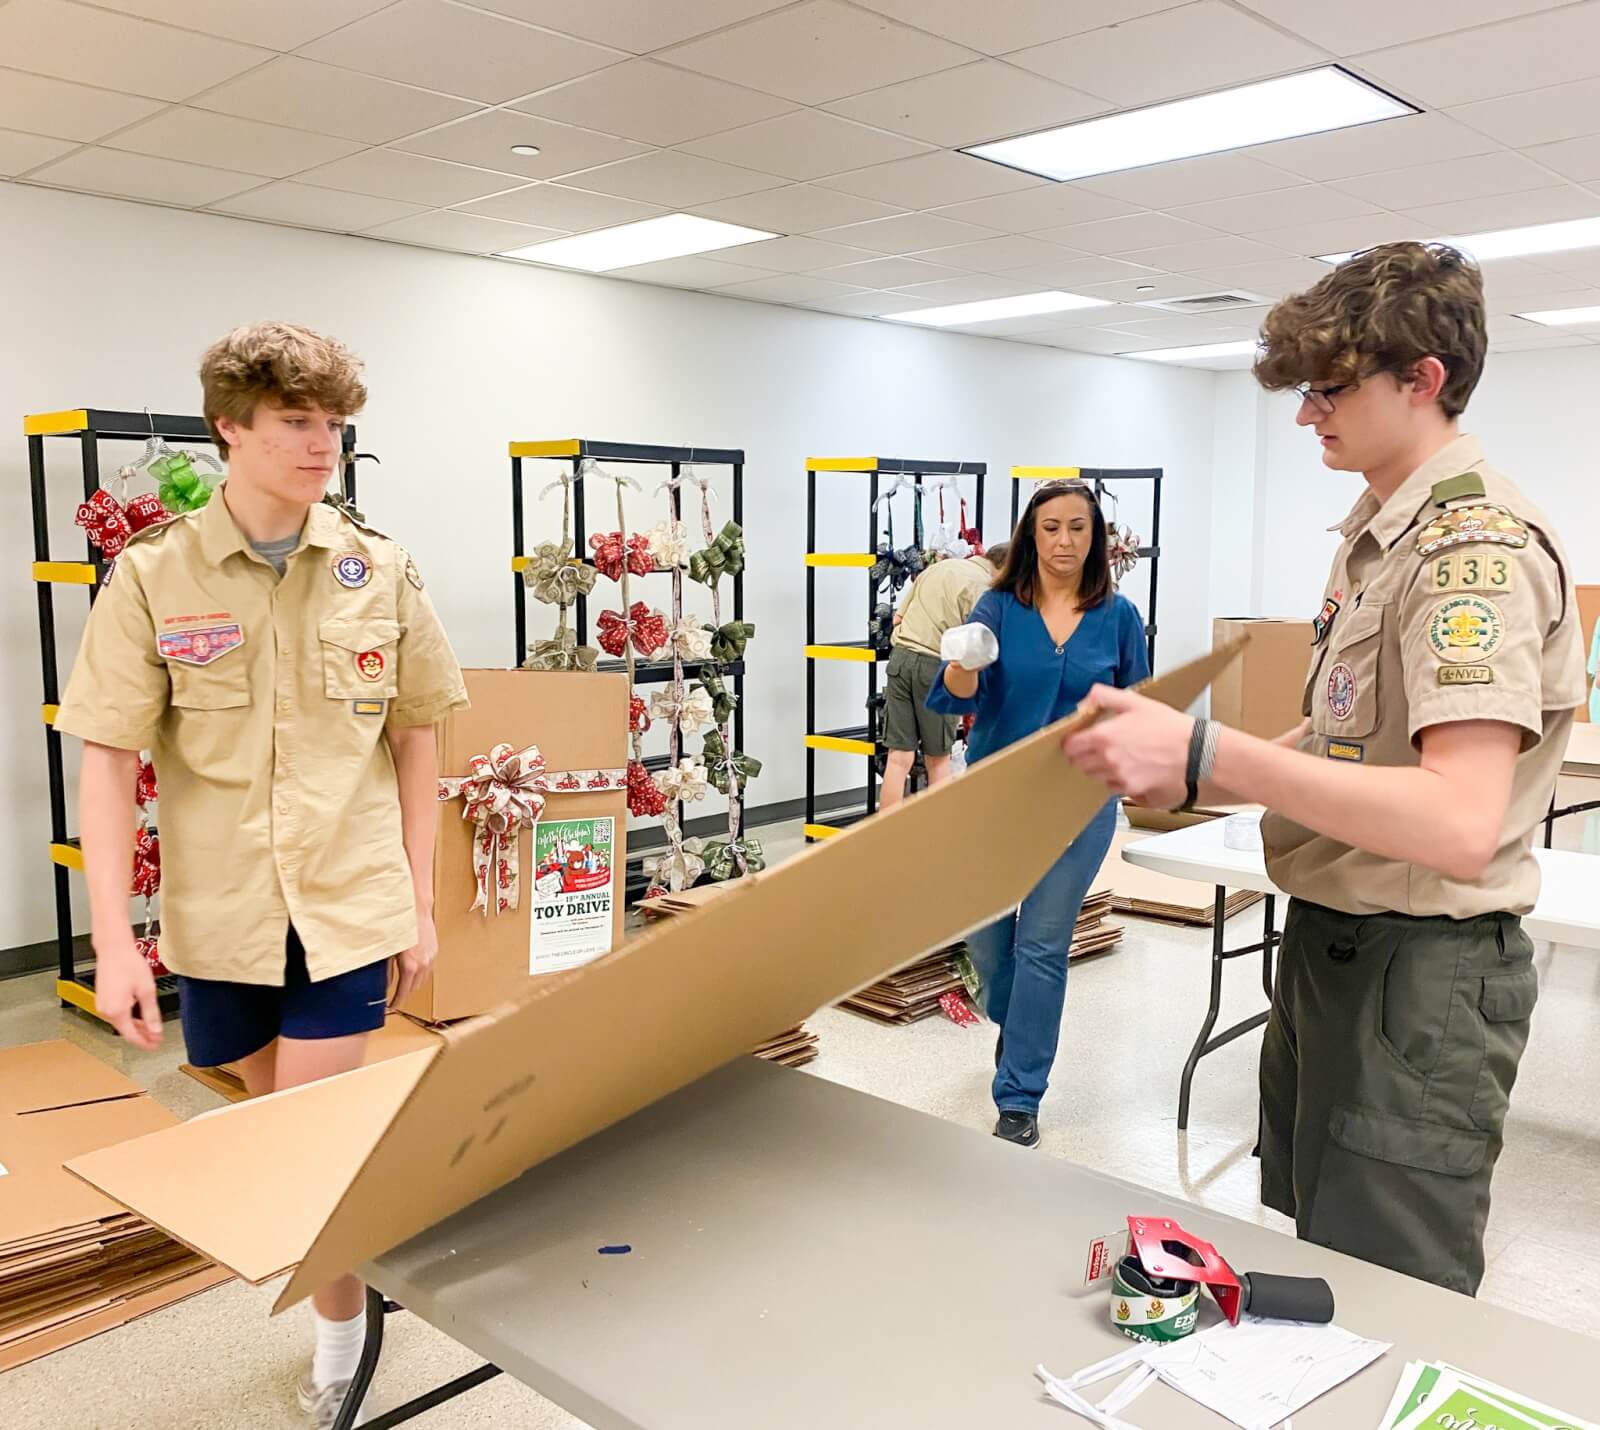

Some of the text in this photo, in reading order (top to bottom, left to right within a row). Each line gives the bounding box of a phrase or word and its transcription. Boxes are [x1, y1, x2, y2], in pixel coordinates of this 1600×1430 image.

[140, 501, 159, 516] HO
[1436, 559, 1507, 587] 533
[1430, 599, 1501, 652] ASSISTANT SENIOR PATROL LEADER
[1455, 669, 1488, 680] NYLT
[534, 899, 611, 920] TOY DRIVE
